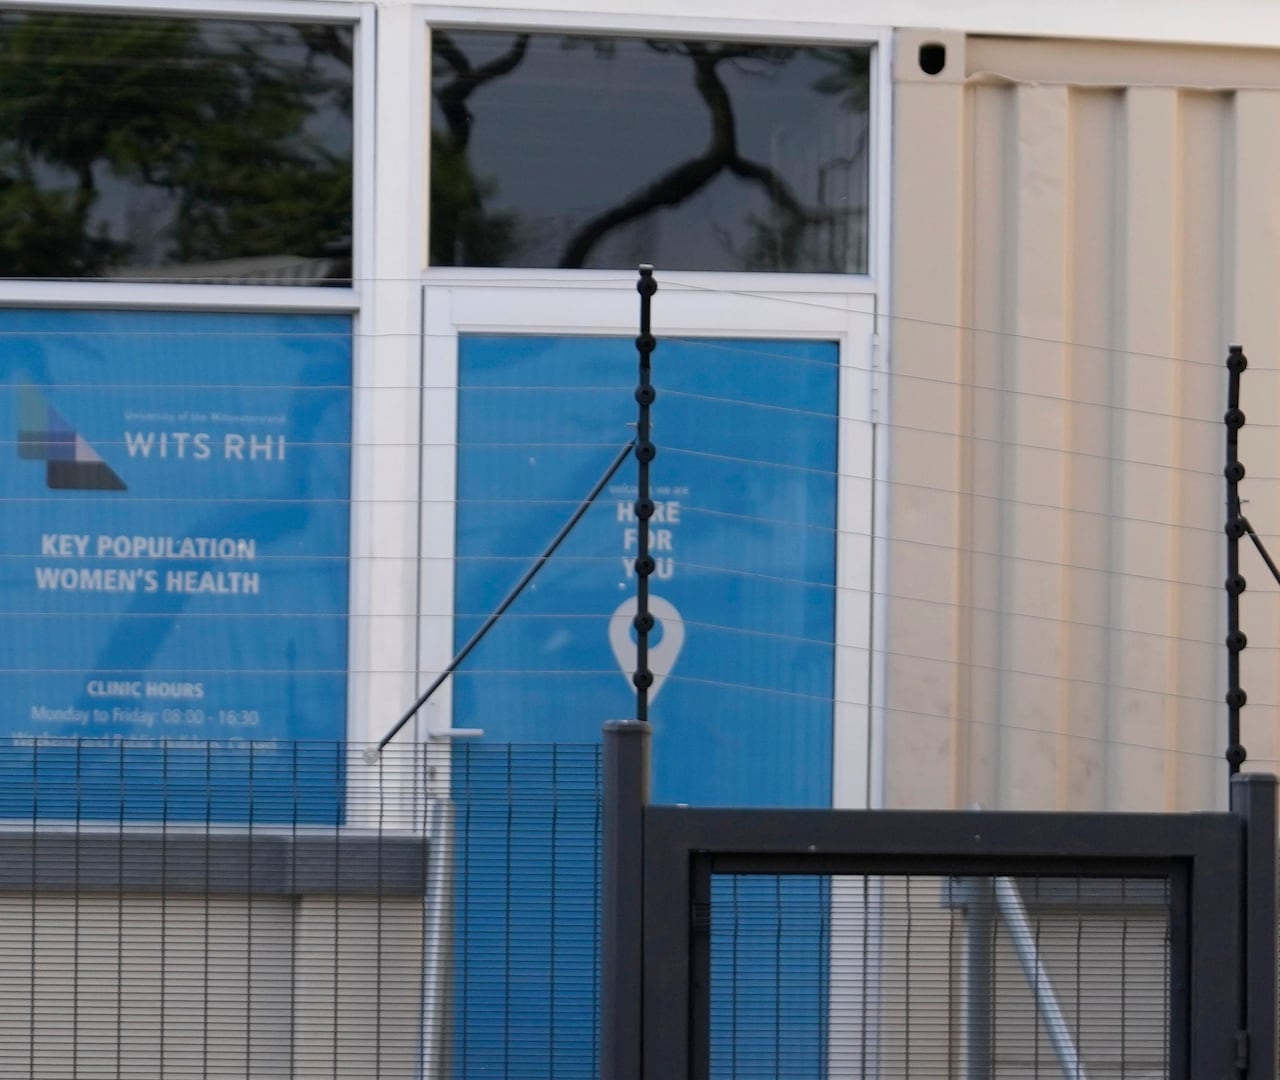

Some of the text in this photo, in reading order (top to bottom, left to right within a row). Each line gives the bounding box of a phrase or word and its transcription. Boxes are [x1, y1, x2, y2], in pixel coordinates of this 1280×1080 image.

[124, 431, 286, 461] WITS RHI
[617, 500, 680, 523] HRE
[41, 533, 255, 560] KEY POPULATION
[623, 556, 673, 579] YU
[35, 566, 260, 595] WOMEN'S HEALTH
[87, 680, 204, 698] CLINIC HOURS
[30, 705, 88, 726] Monday
[93, 707, 108, 722] to
[219, 709, 260, 726] 16:30
